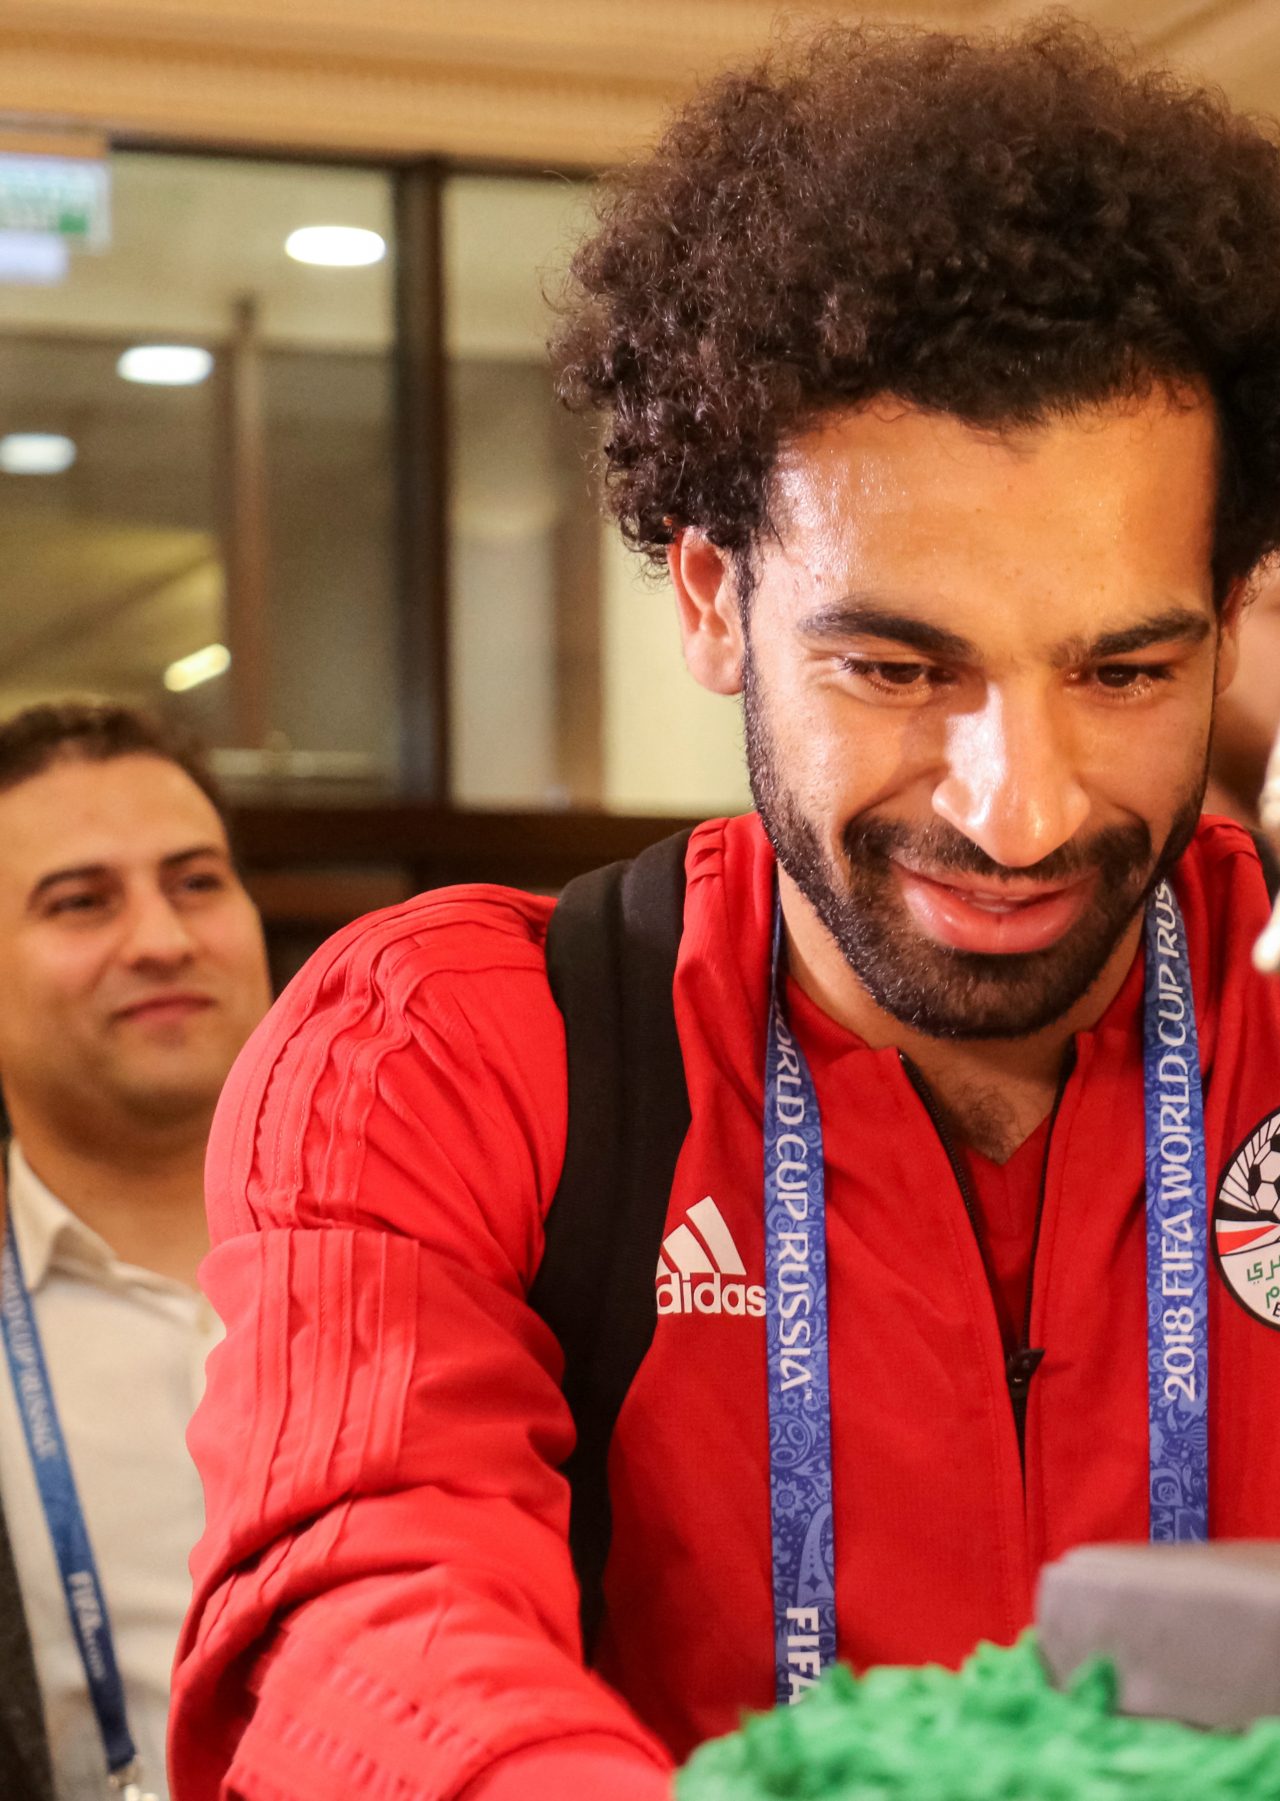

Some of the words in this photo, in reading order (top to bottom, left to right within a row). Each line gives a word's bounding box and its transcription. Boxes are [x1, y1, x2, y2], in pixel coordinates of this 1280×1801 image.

[1154, 878, 1180, 958] RUS
[1157, 963, 1187, 1046] CUP
[774, 1004, 805, 1125] ORLD
[1158, 1054, 1193, 1201] WORLD
[775, 1133, 809, 1221] CUP
[656, 1272, 767, 1317] didas
[1161, 1209, 1194, 1297] FIFA
[776, 1232, 812, 1392] RUSSIA
[1163, 1306, 1196, 1402] 2018
[786, 1607, 821, 1706] FIFA
